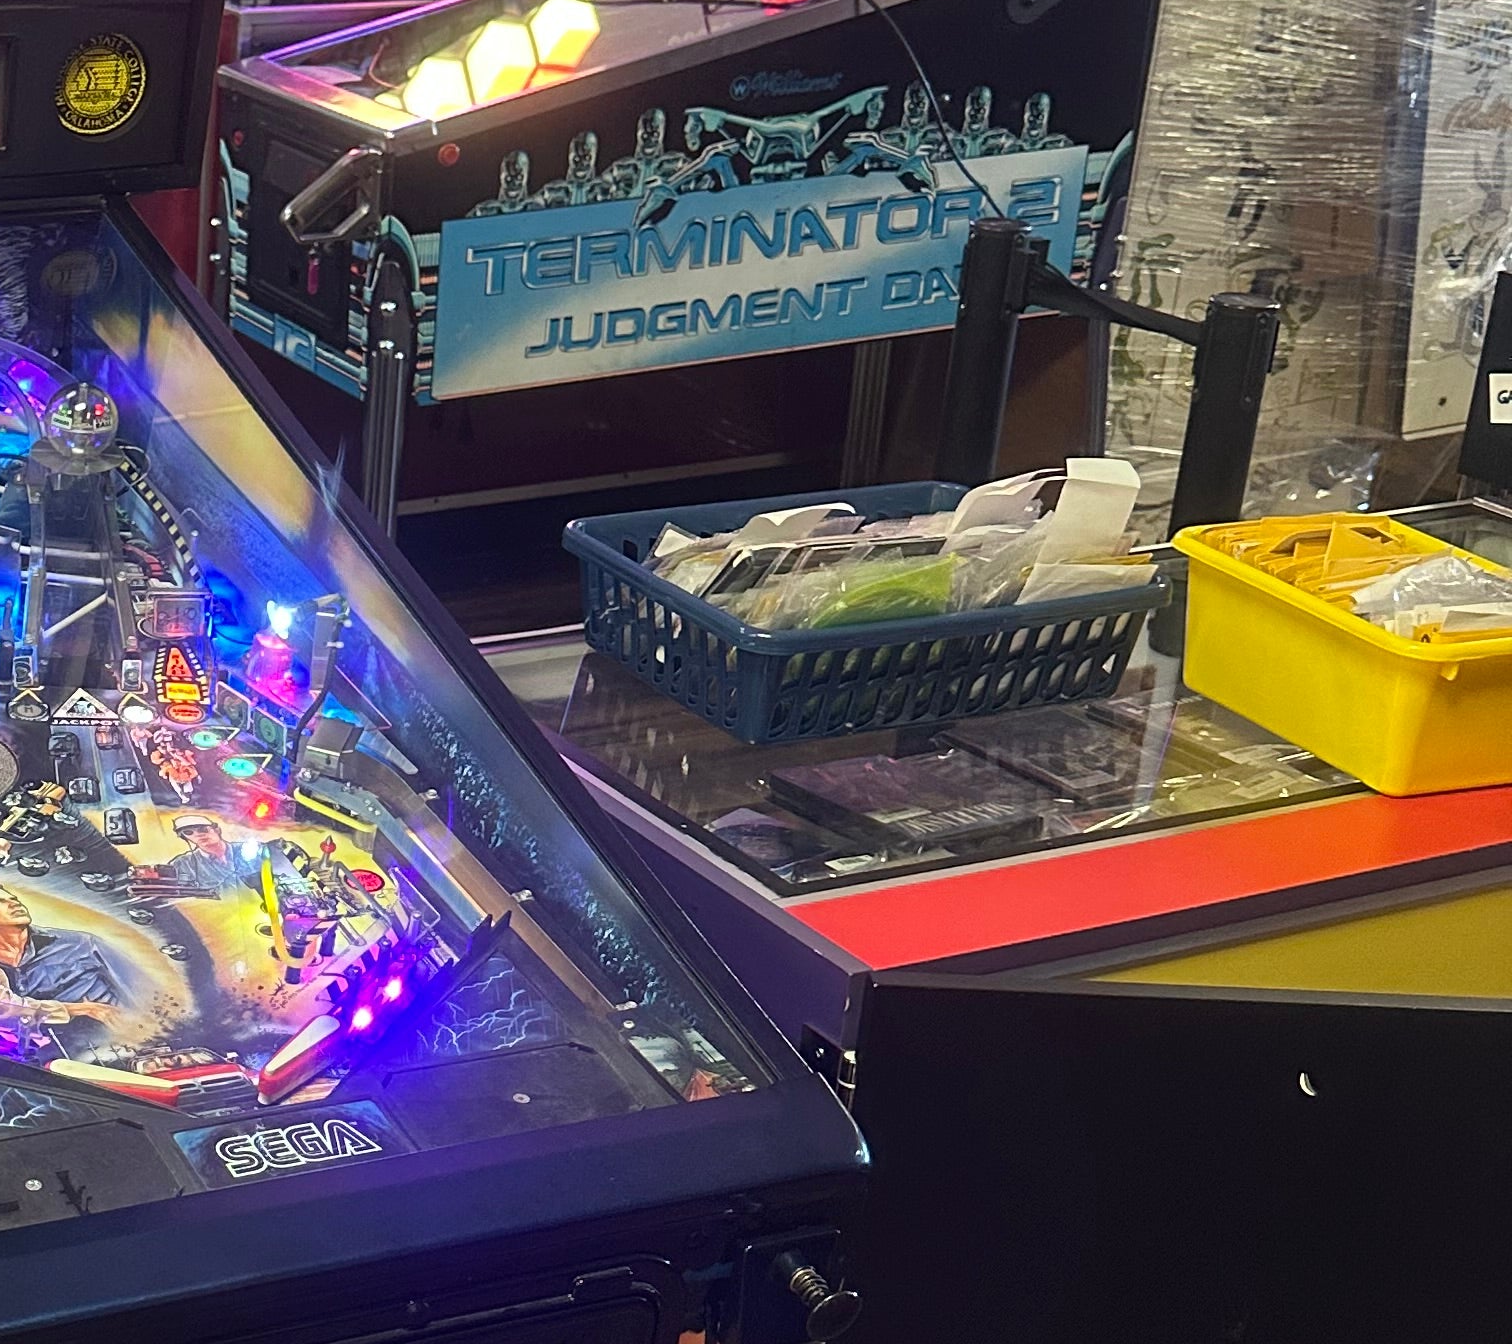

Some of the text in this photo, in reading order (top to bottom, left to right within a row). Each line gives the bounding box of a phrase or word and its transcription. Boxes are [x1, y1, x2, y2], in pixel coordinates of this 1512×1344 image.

[466, 176, 1063, 297] TERMINATOR 2
[524, 277, 867, 360] JUDGMENT
[51, 718, 121, 726] JACKPOT
[214, 1119, 383, 1178] SEGA
